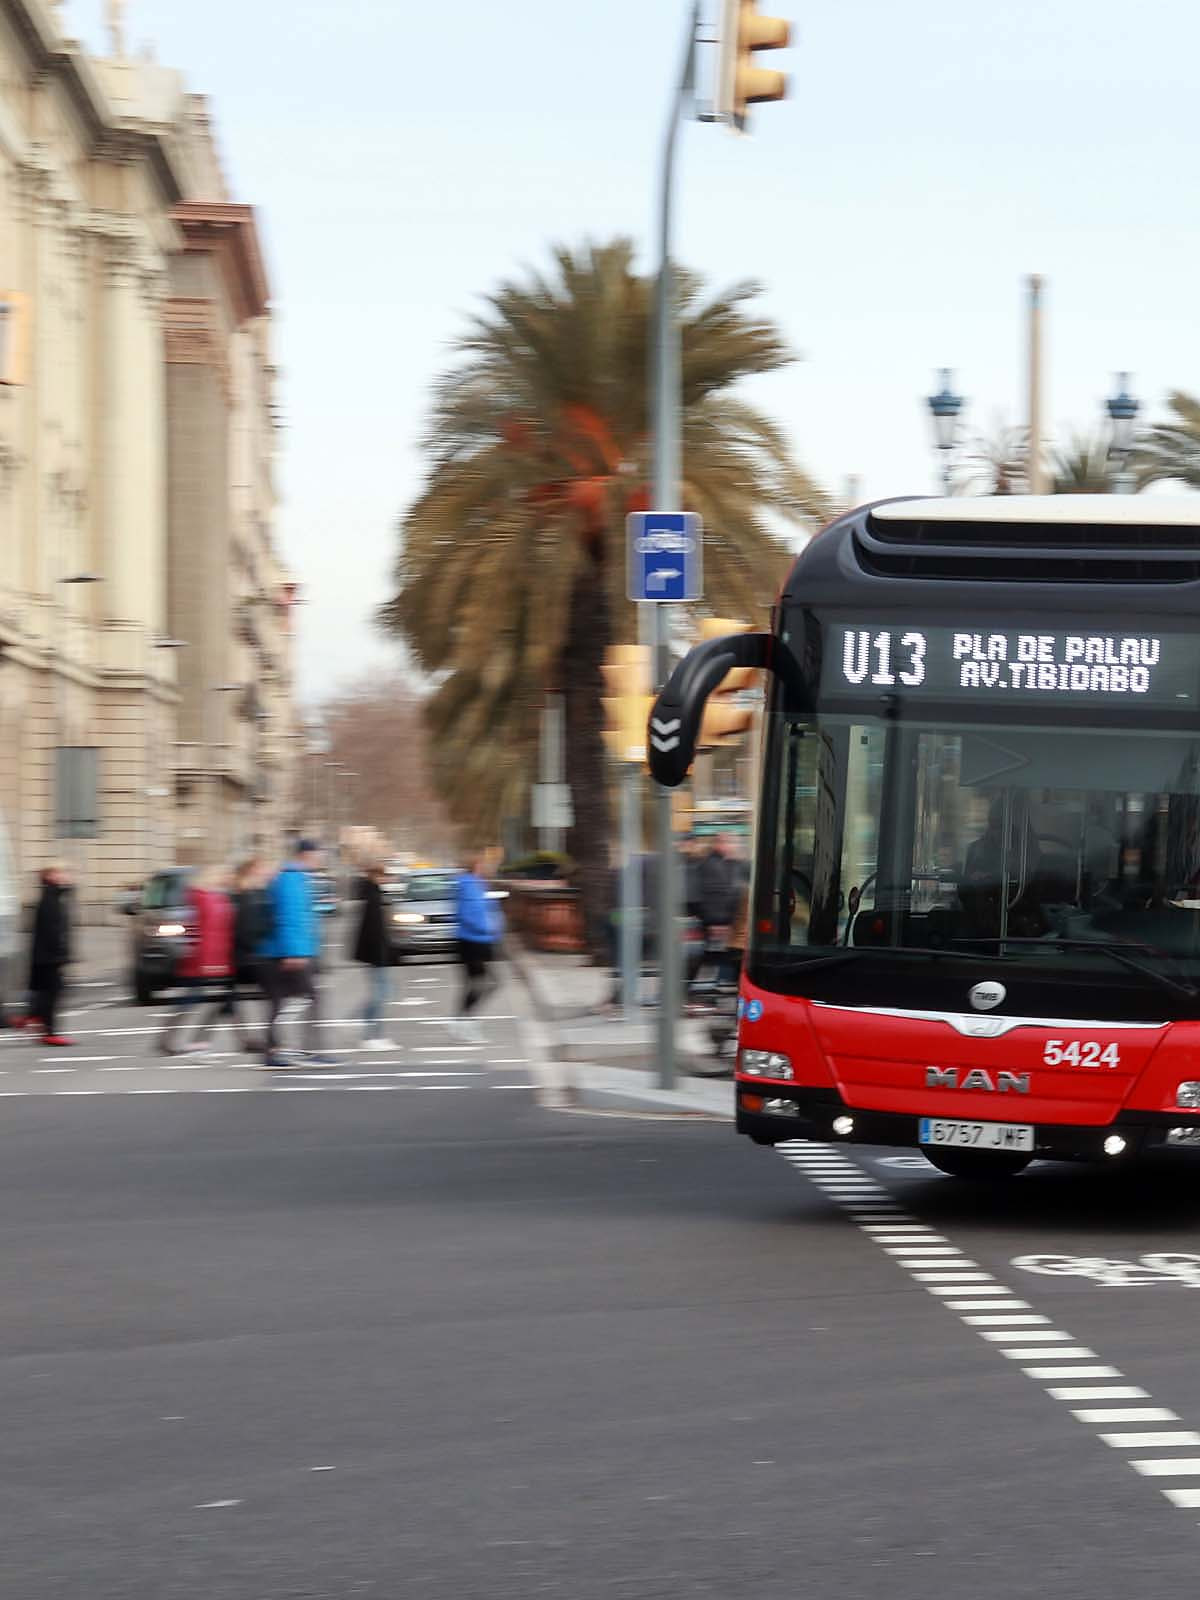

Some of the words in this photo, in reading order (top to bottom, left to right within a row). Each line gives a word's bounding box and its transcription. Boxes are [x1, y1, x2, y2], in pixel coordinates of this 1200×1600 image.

[842, 631, 927, 685] U13
[953, 633, 1008, 661] PLA
[1017, 635, 1056, 662] DE
[1065, 636, 1160, 665] PALAU
[960, 662, 1150, 692] AV.TIBIDABO
[1043, 1040, 1121, 1068] 5424
[925, 1066, 1032, 1094] MAN
[934, 1122, 984, 1144] 6757
[992, 1127, 1030, 1147] JWF
